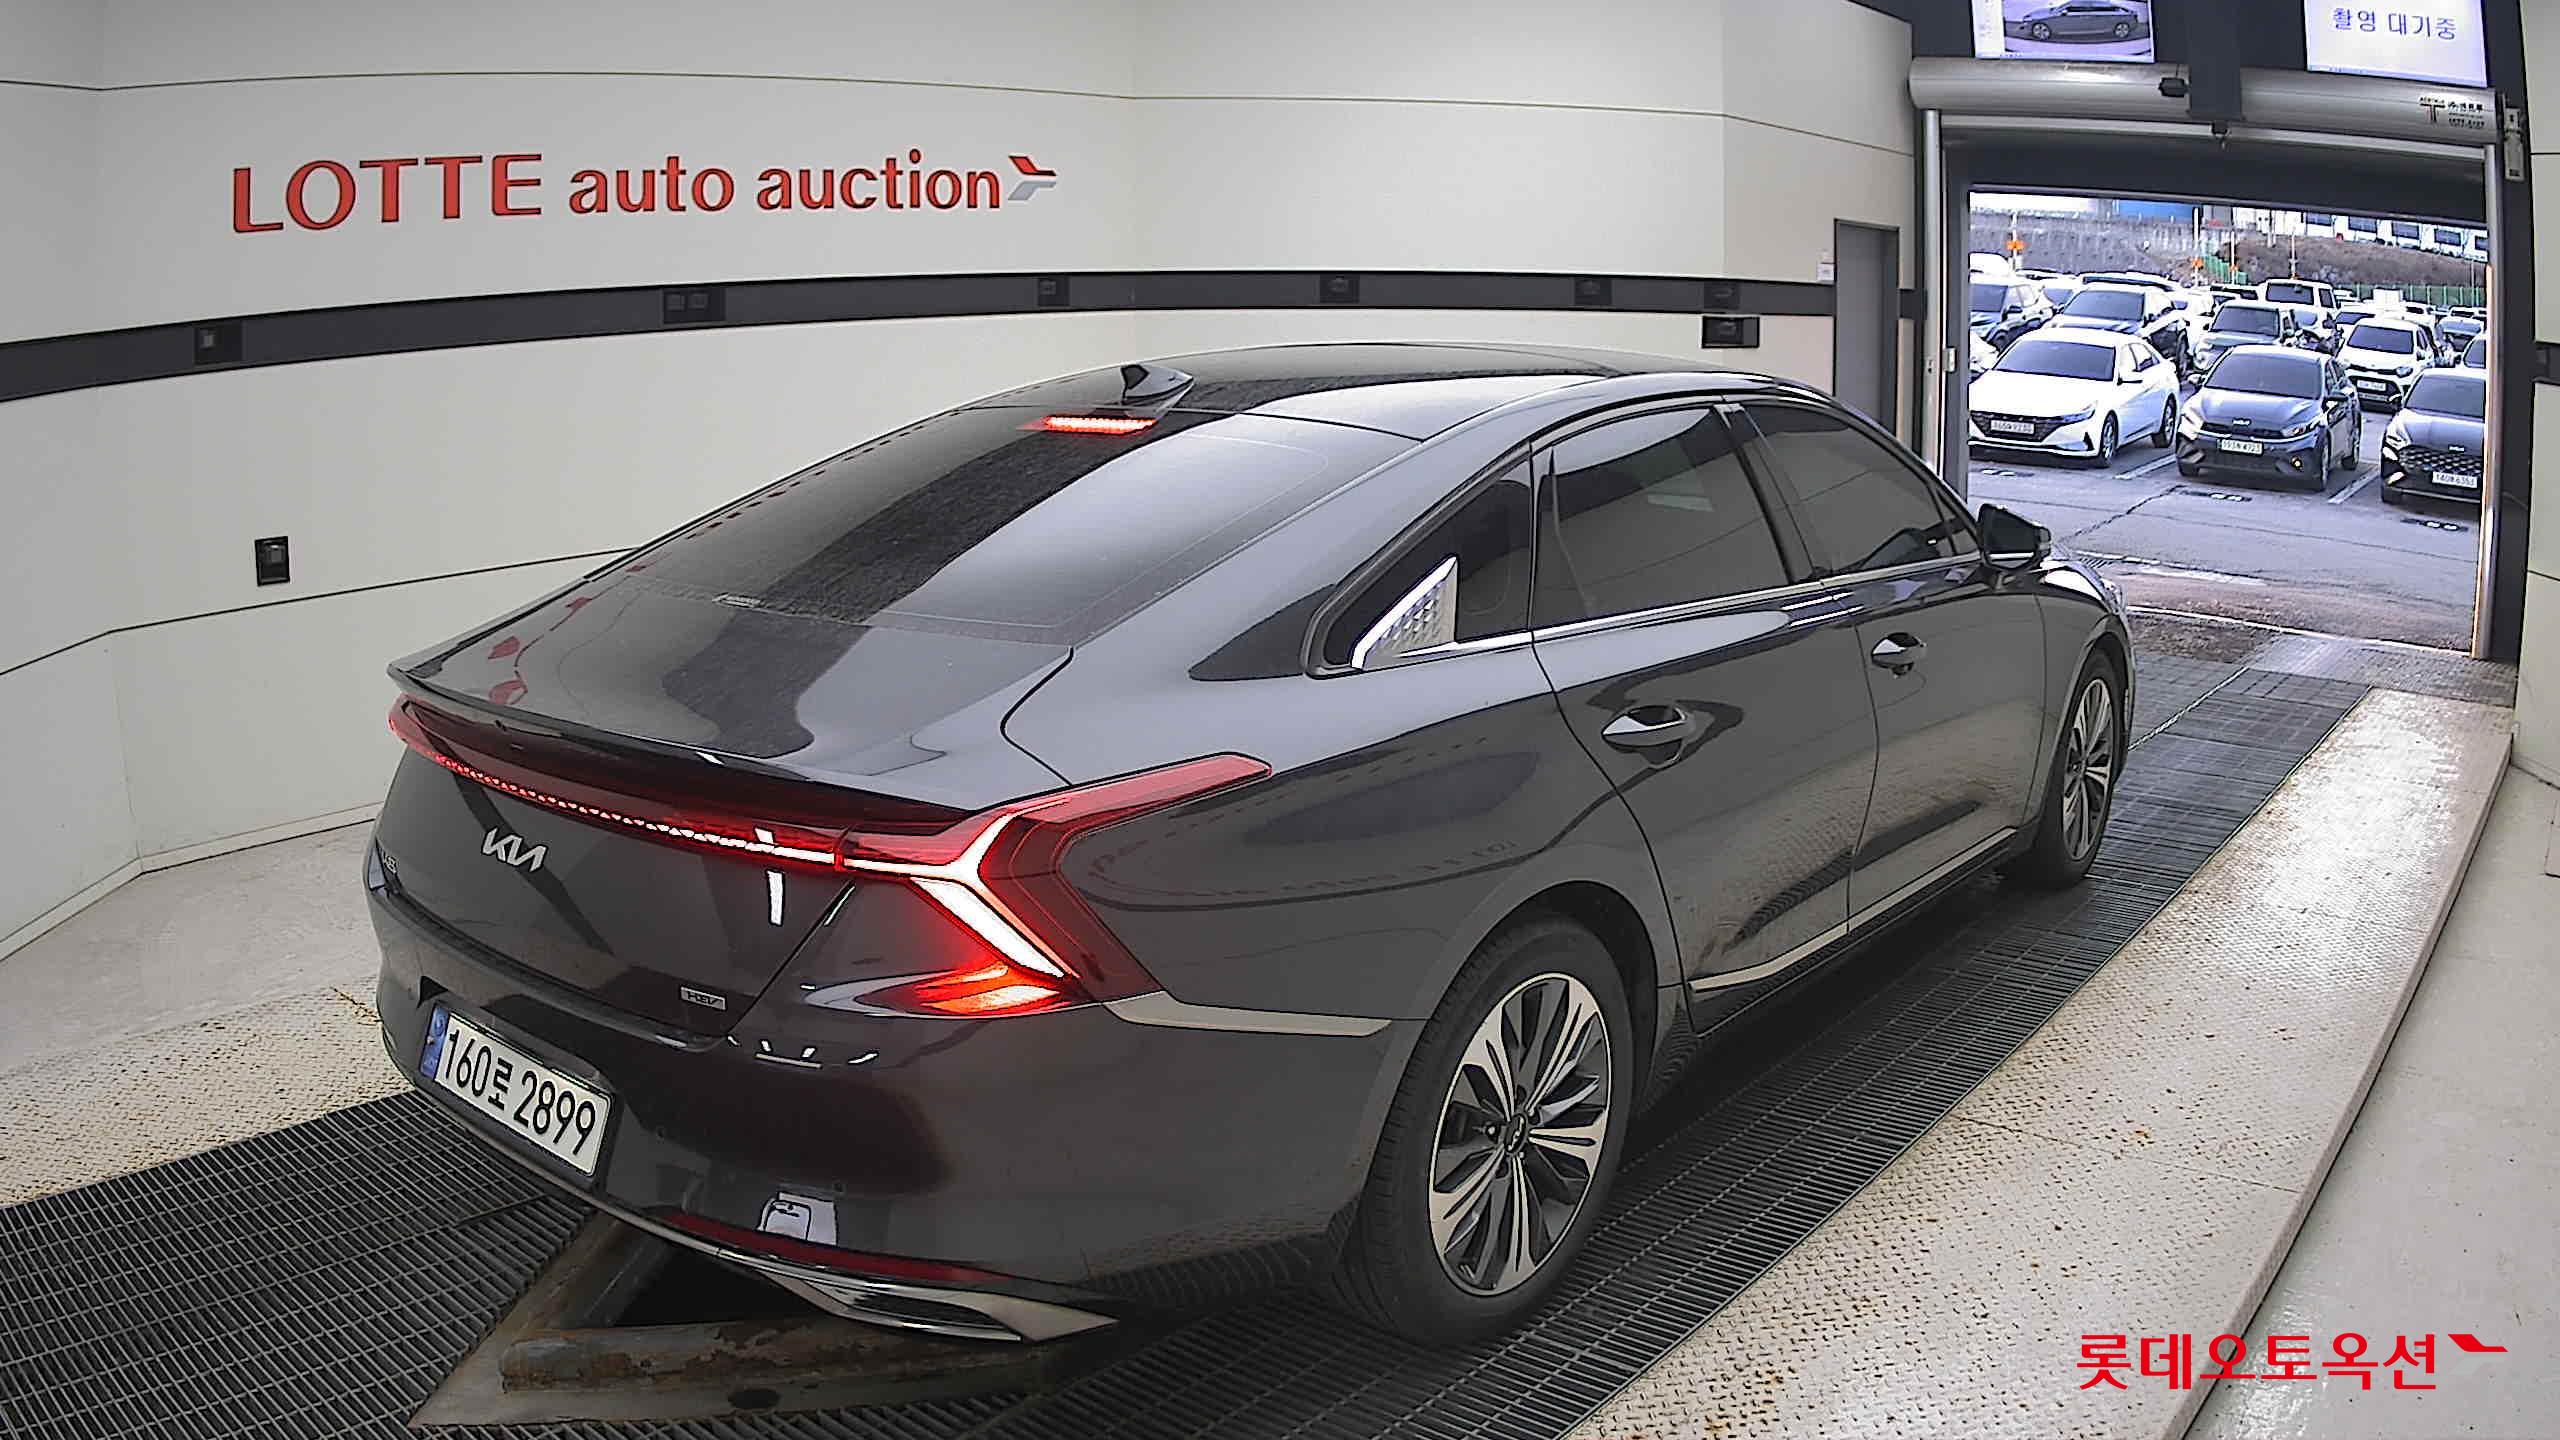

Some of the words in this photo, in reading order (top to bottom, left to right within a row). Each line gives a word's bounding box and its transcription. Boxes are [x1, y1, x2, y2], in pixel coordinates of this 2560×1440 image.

[2333, 8, 2376, 32] 촬영
[2388, 13, 2457, 40] 대기중
[233, 154, 541, 233] LOTTE
[568, 154, 735, 214] auto
[756, 148, 1001, 210] auction
[446, 1029, 514, 1111] 160로
[513, 1070, 596, 1156] 2899
